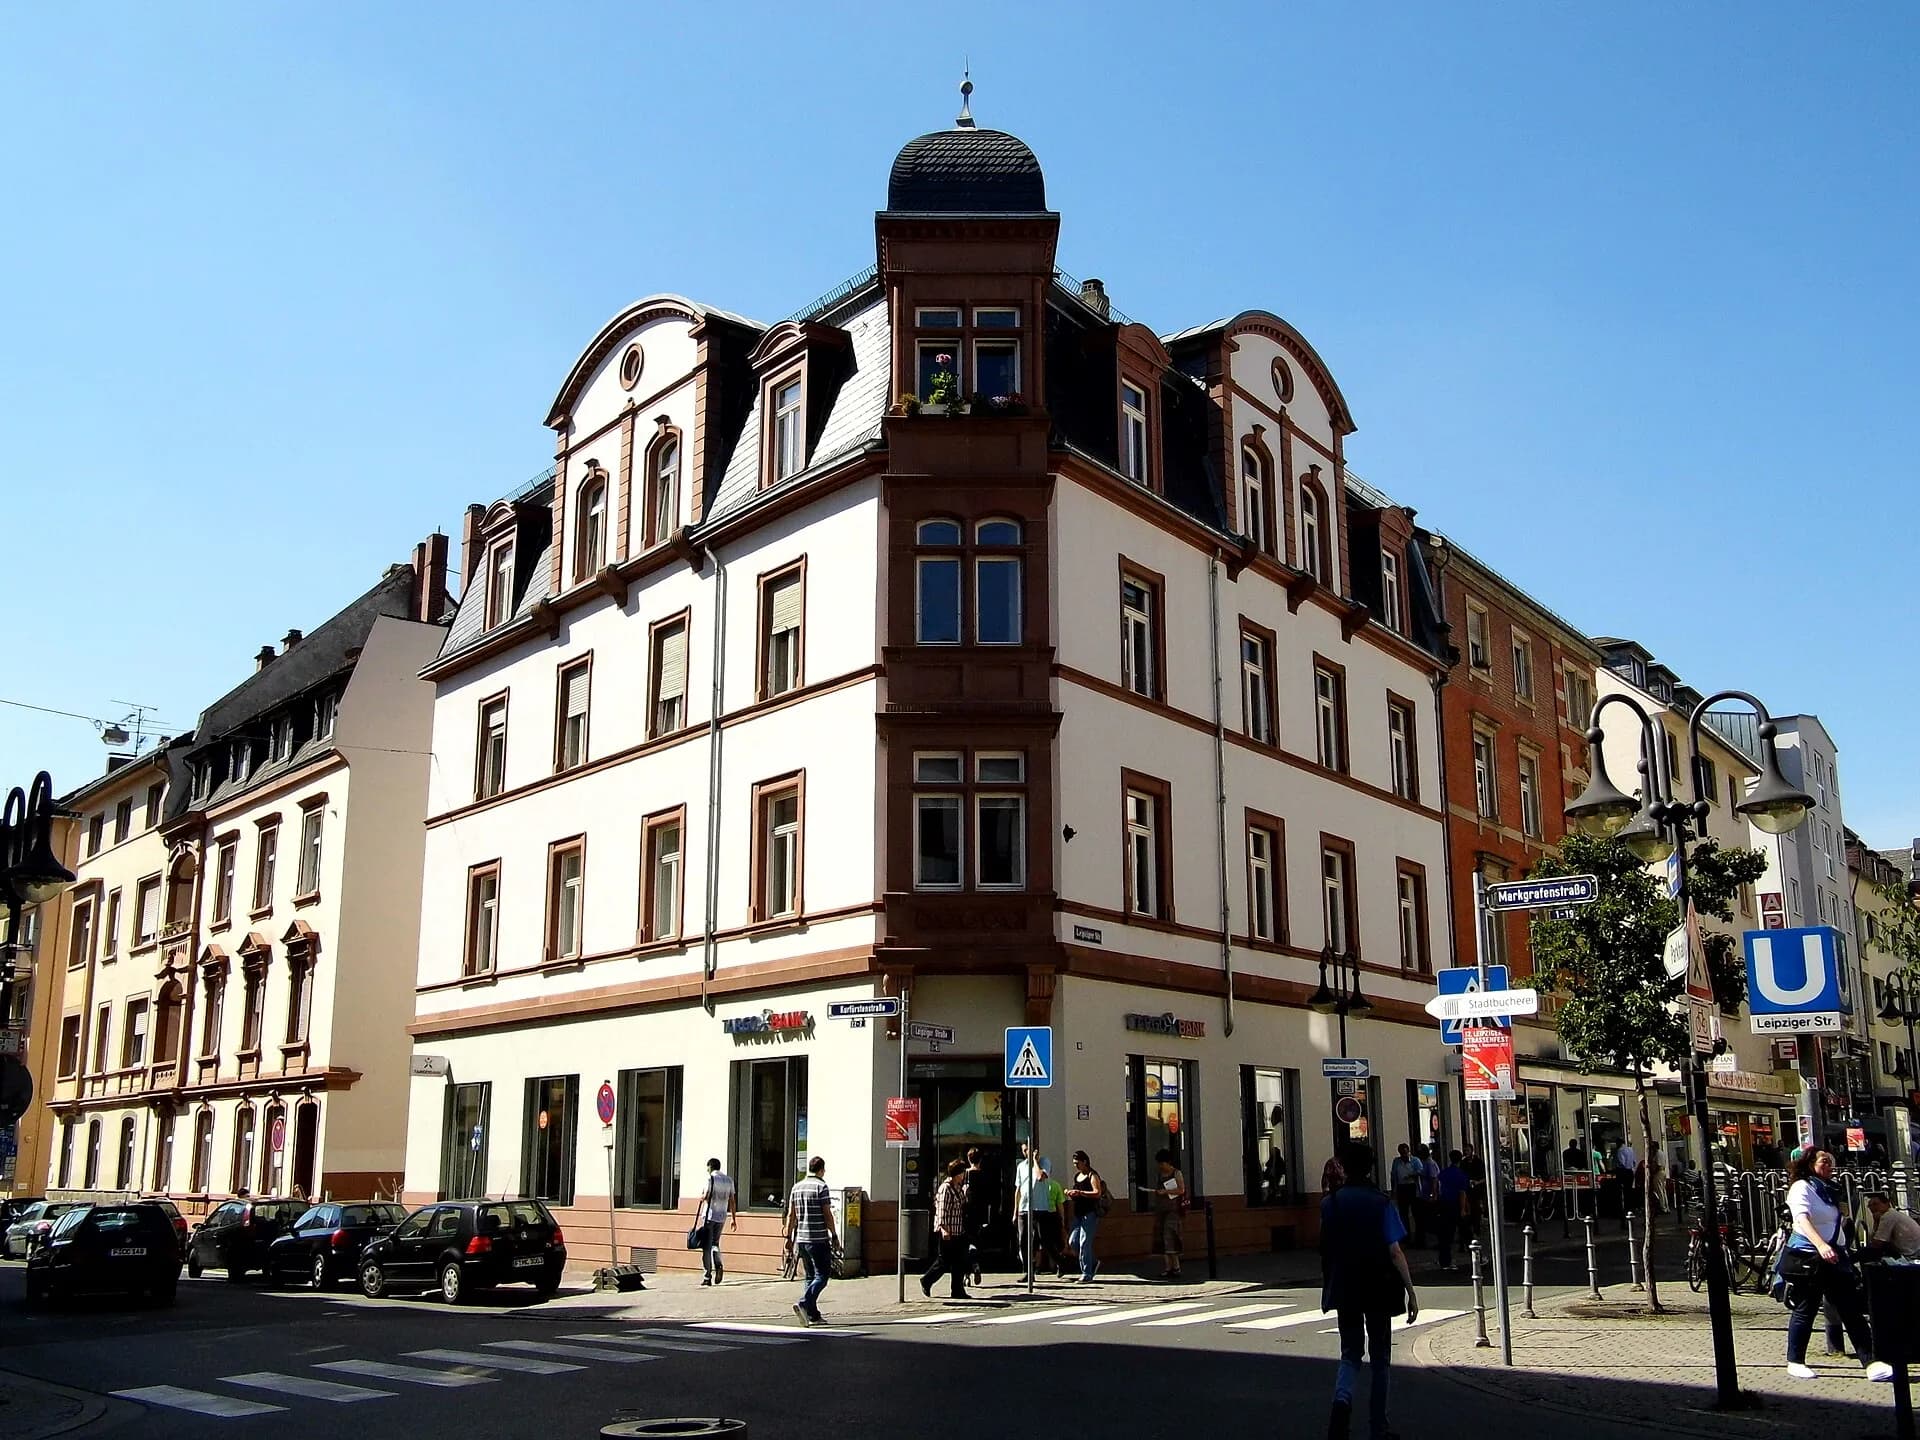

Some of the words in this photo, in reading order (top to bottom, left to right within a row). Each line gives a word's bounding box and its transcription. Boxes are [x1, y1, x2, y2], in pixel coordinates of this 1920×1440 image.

[1498, 884, 1586, 903] Markgrafenstraße
[1752, 934, 1826, 1006] U
[1756, 1017, 1811, 1030] Leipziger
[1814, 1016, 1836, 1027] Str.
